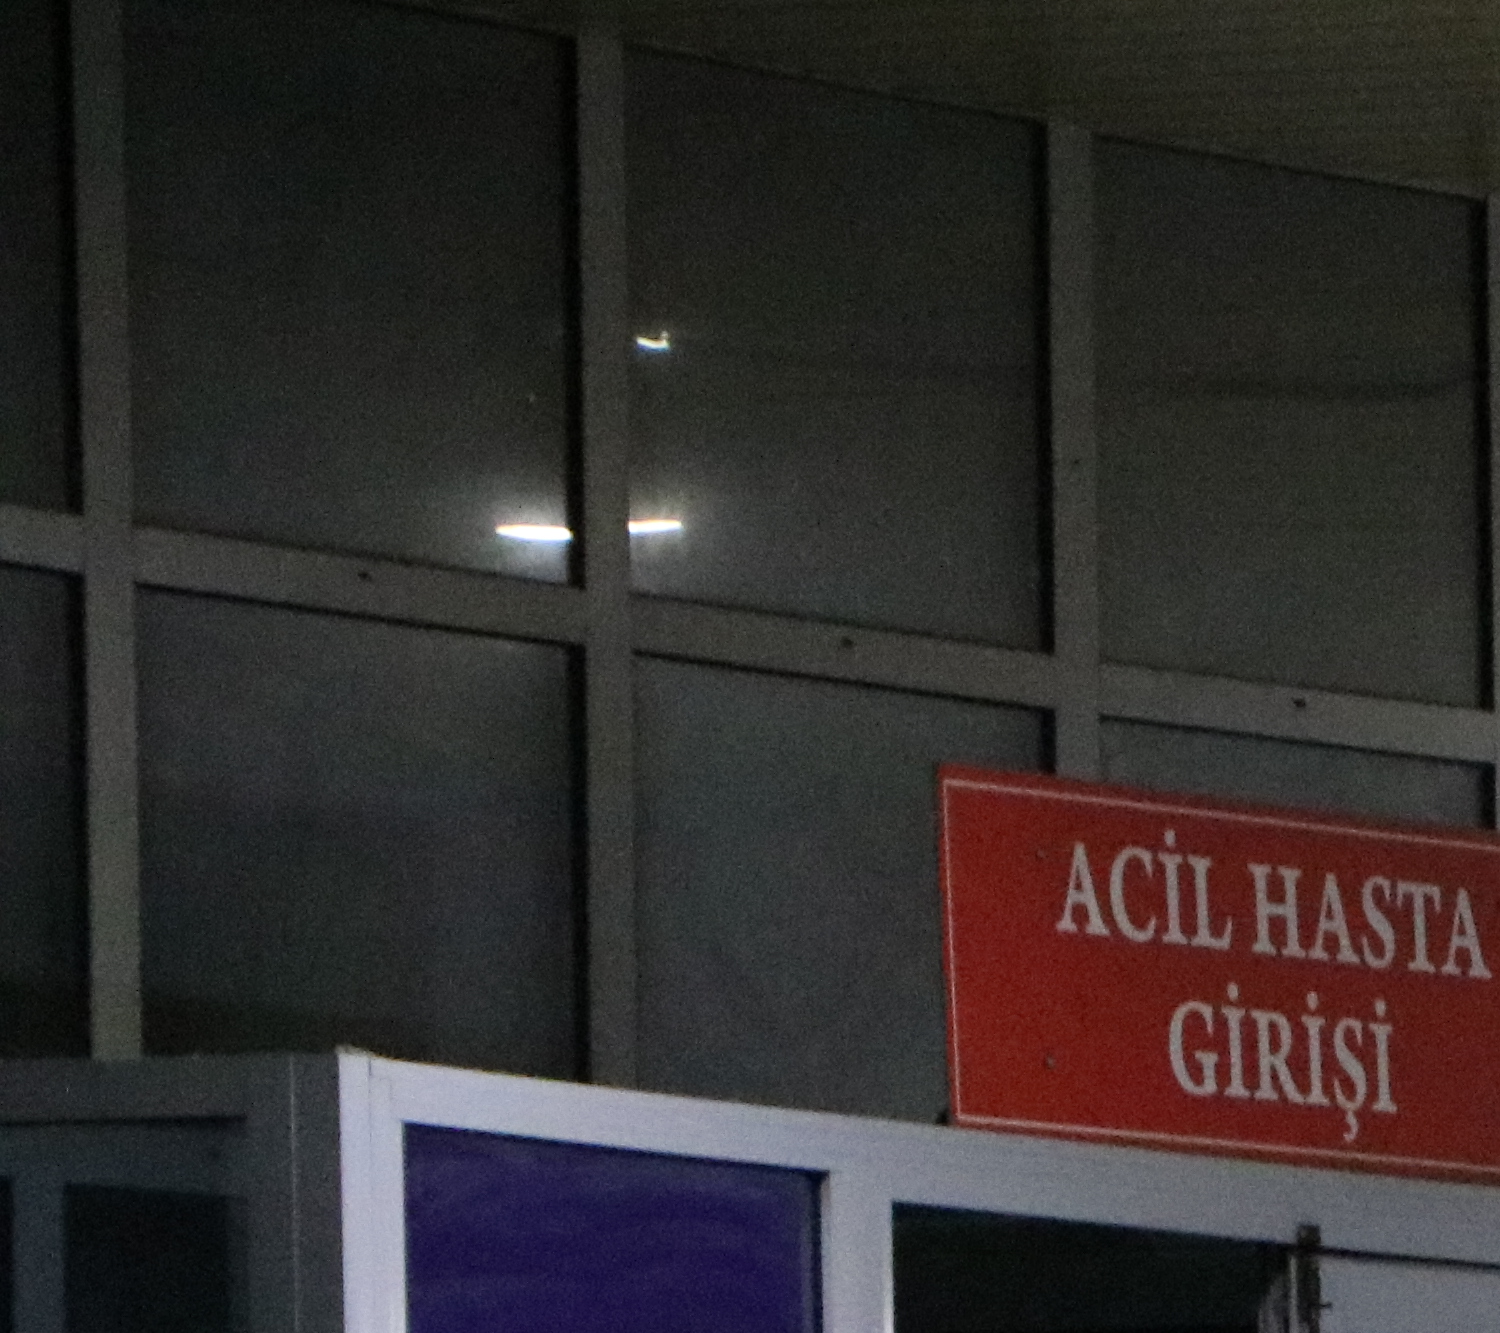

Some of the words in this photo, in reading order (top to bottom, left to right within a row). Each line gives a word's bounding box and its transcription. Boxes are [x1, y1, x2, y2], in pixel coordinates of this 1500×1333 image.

[1056, 828, 1233, 951] ACİL
[1248, 861, 1493, 979] HASTA
[1168, 982, 1398, 1141] GİRİŞİ
